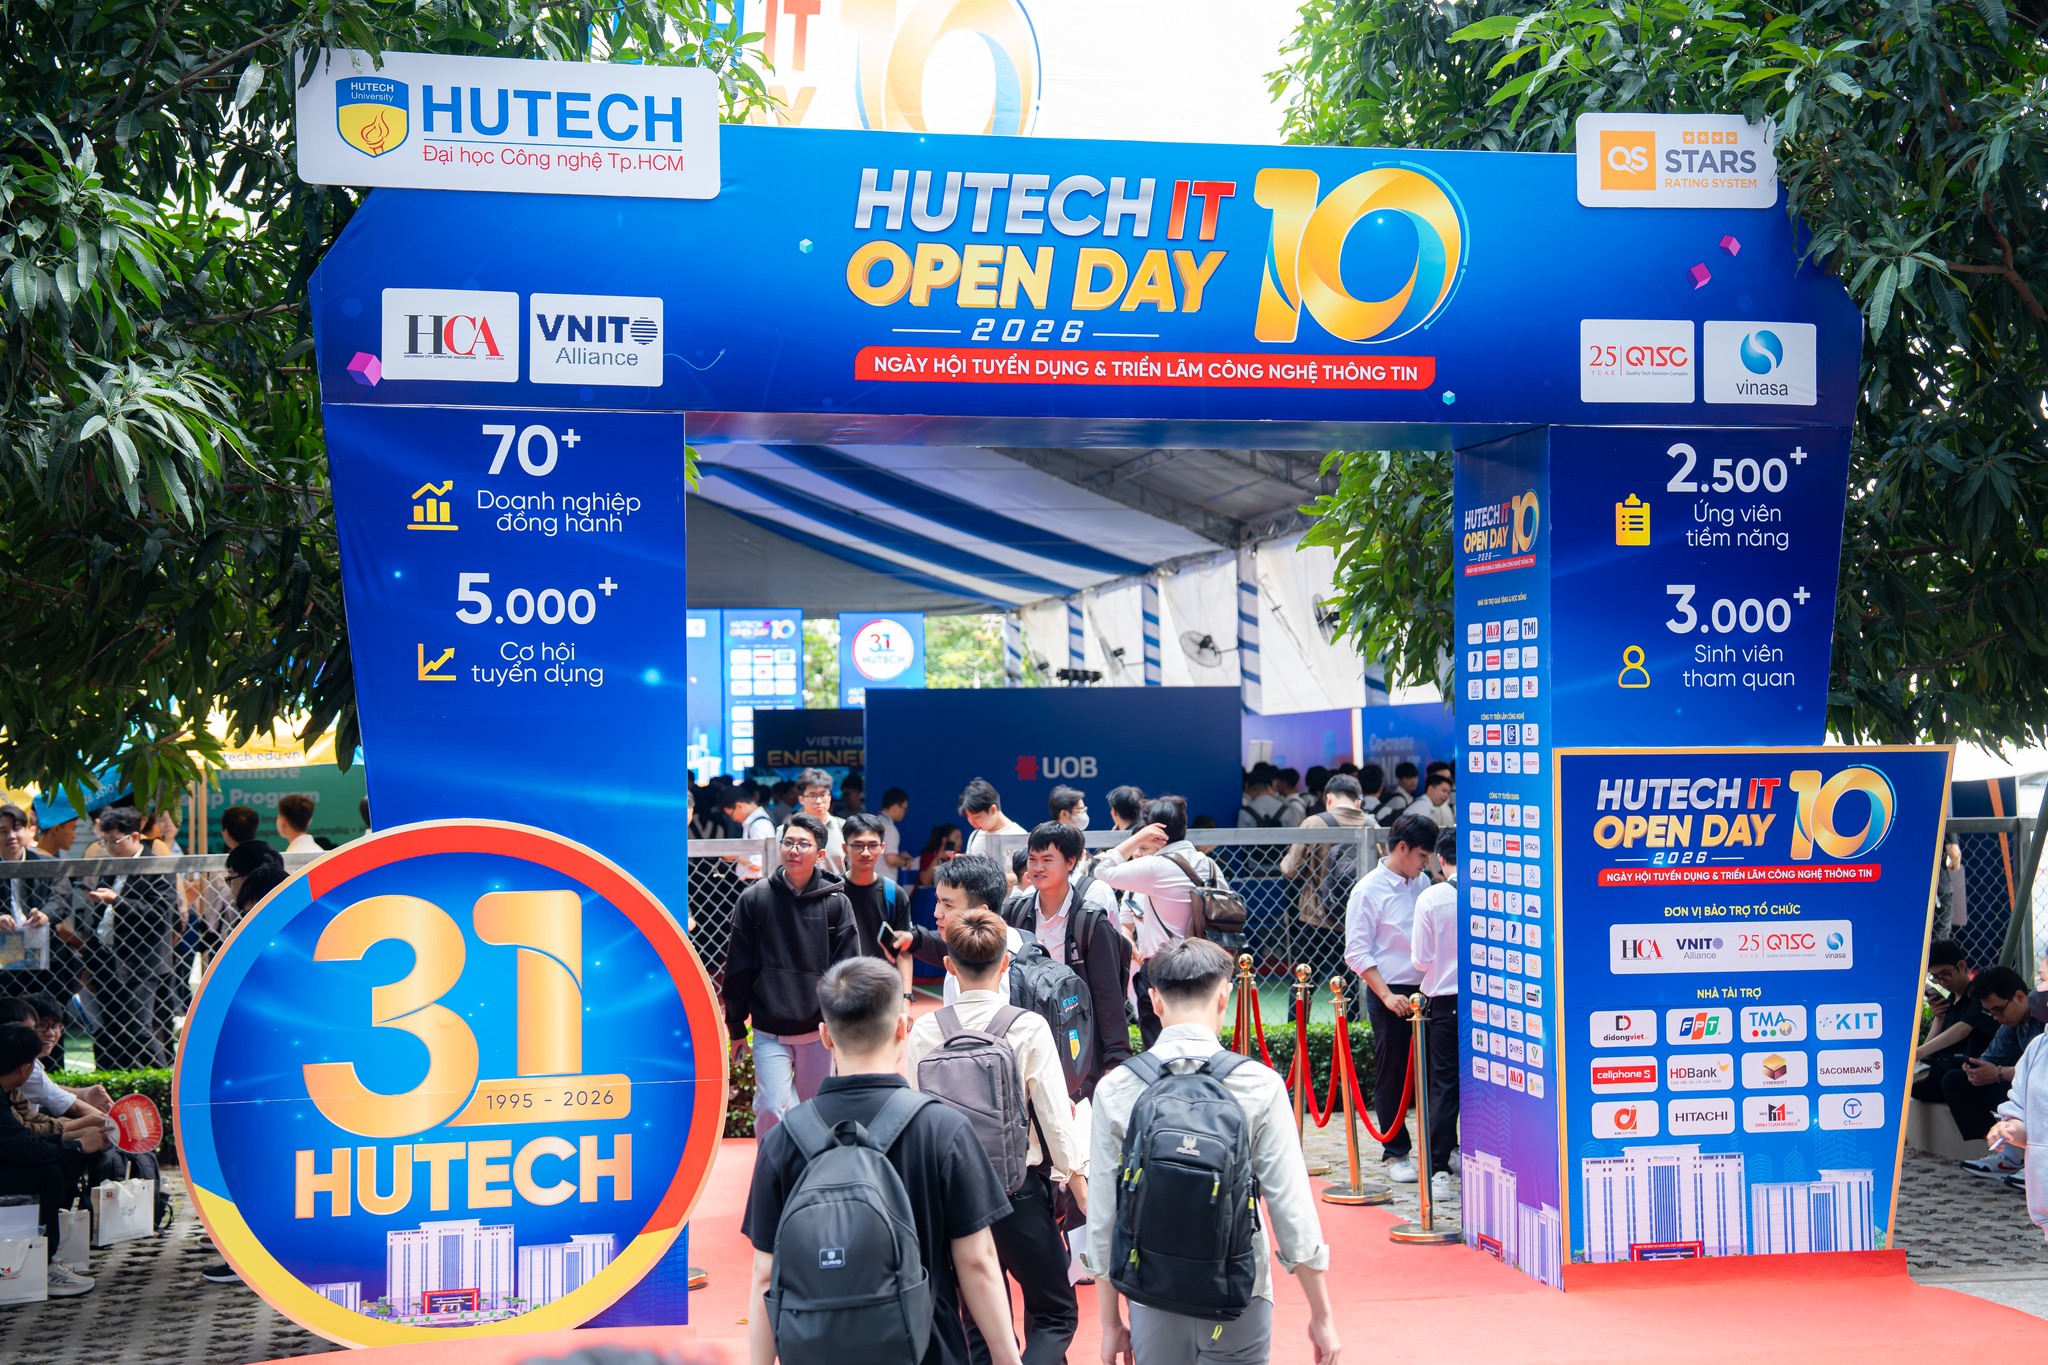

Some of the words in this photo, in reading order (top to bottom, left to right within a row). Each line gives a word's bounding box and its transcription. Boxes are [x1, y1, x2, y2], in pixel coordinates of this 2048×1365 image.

[350, 82, 394, 92] HUTECH
[351, 92, 394, 102] University
[422, 85, 682, 143] HUTECH
[423, 145, 453, 163] Đại
[460, 147, 494, 167] học
[500, 148, 550, 170] Công
[557, 152, 602, 172] nghệ
[608, 153, 684, 173] Tp.HCM
[1608, 145, 1648, 175] QS
[1665, 149, 1756, 174] STARS
[1665, 178, 1709, 188] RATING
[1712, 178, 1757, 188] SYSTEM
[854, 167, 1156, 238] HUTECH
[1166, 179, 1236, 241] IT
[1253, 166, 1463, 344] 10
[845, 239, 1054, 310] OPEN
[1070, 246, 1230, 314] DAY
[404, 314, 504, 356] HCA
[971, 318, 1084, 343] 2026
[556, 348, 638, 366] Alliance
[1589, 345, 1617, 366] 25
[1626, 346, 1688, 367] QTSC
[874, 353, 928, 373] NGÀY
[934, 354, 967, 378] HỘI
[972, 353, 1030, 376] TUYỂN
[1036, 360, 1089, 380] DỤNG
[1094, 360, 1106, 377] &
[1112, 355, 1162, 377] TRIỂN
[1166, 358, 1202, 378] LÃM
[1208, 360, 1264, 379] CÔNG
[1268, 361, 1318, 384] NGHỆ
[1322, 362, 1386, 380] THÔNG
[1390, 366, 1418, 381] TIN
[1736, 380, 1788, 396] vinasa
[482, 424, 580, 476] 70+
[1666, 442, 1807, 493] 2.500+
[477, 490, 554, 510] Doanh
[562, 492, 641, 516] nghiệp
[1693, 498, 1734, 526] Ứng
[1740, 504, 1781, 522] viên
[496, 510, 558, 536] đồng
[566, 512, 623, 532] hành
[1464, 504, 1500, 530] HUTECH
[1501, 502, 1510, 524] IT
[1512, 491, 1539, 554] 10
[1464, 530, 1488, 554] OPEN
[1490, 525, 1509, 550] DAY
[1686, 526, 1730, 547] tiềm
[1737, 528, 1789, 551] năng
[455, 572, 618, 625] 5.000+
[1665, 584, 1811, 634] 3.000+
[500, 641, 534, 661] Cơ
[542, 641, 575, 664] hội
[869, 633, 890, 652] 31
[1694, 644, 1736, 663] Sinh
[1742, 644, 1783, 662] viên
[862, 654, 904, 664] HUTECH
[470, 660, 537, 687] tuyển
[544, 664, 604, 687] dụng
[1682, 668, 1736, 688] tham
[1742, 670, 1795, 691] quan
[767, 750, 864, 766] ENGINE
[1042, 756, 1098, 778] UOB
[230, 789, 320, 808] Progrm
[1596, 778, 1741, 810] HUTECH
[1747, 778, 1781, 810] IT
[1790, 767, 1893, 860] 10
[1593, 815, 1692, 849] OPEN
[1701, 813, 1777, 847] DAY
[1653, 851, 1708, 865] 2026
[1606, 870, 1634, 882] NGÀY
[1634, 870, 1651, 884] HỘI
[1653, 868, 1683, 881] TUYỂN
[1684, 871, 1710, 883] DỤNG
[1712, 872, 1719, 880] &
[1721, 868, 1746, 881] TRIỂN
[1747, 868, 1766, 880] LÃM
[1768, 868, 1795, 880] CÔNG
[1797, 868, 1822, 881] NGHỆ
[1824, 868, 1856, 878] THÔNG
[1858, 869, 1872, 878] TIN
[1664, 905, 1689, 917] ĐƠN
[1691, 906, 1702, 918] VỊ
[1704, 903, 1726, 916] BẢO
[1728, 904, 1750, 918] TRỢ
[1752, 902, 1768, 915] TỔ
[1770, 902, 1801, 915] CHỨC
[1621, 938, 1663, 958] HCA
[1738, 934, 1760, 951] 25
[1767, 933, 1816, 950] QTSC
[1684, 952, 1716, 960] Alliance
[1697, 987, 1720, 998] NHÀ
[1721, 986, 1738, 998] TÀI
[1740, 986, 1762, 1000] TRỢ
[302, 890, 582, 1138] 31
[1749, 1012, 1785, 1027] TMA
[1836, 1013, 1878, 1030] KIT
[1670, 1067, 1717, 1079] HDBank
[1820, 1066, 1872, 1075] SACOMBANK
[486, 1092, 534, 1110] 1995
[563, 1090, 614, 1107] 2026
[1675, 1111, 1728, 1122] HITACHI
[295, 1133, 632, 1219] HUTECH
